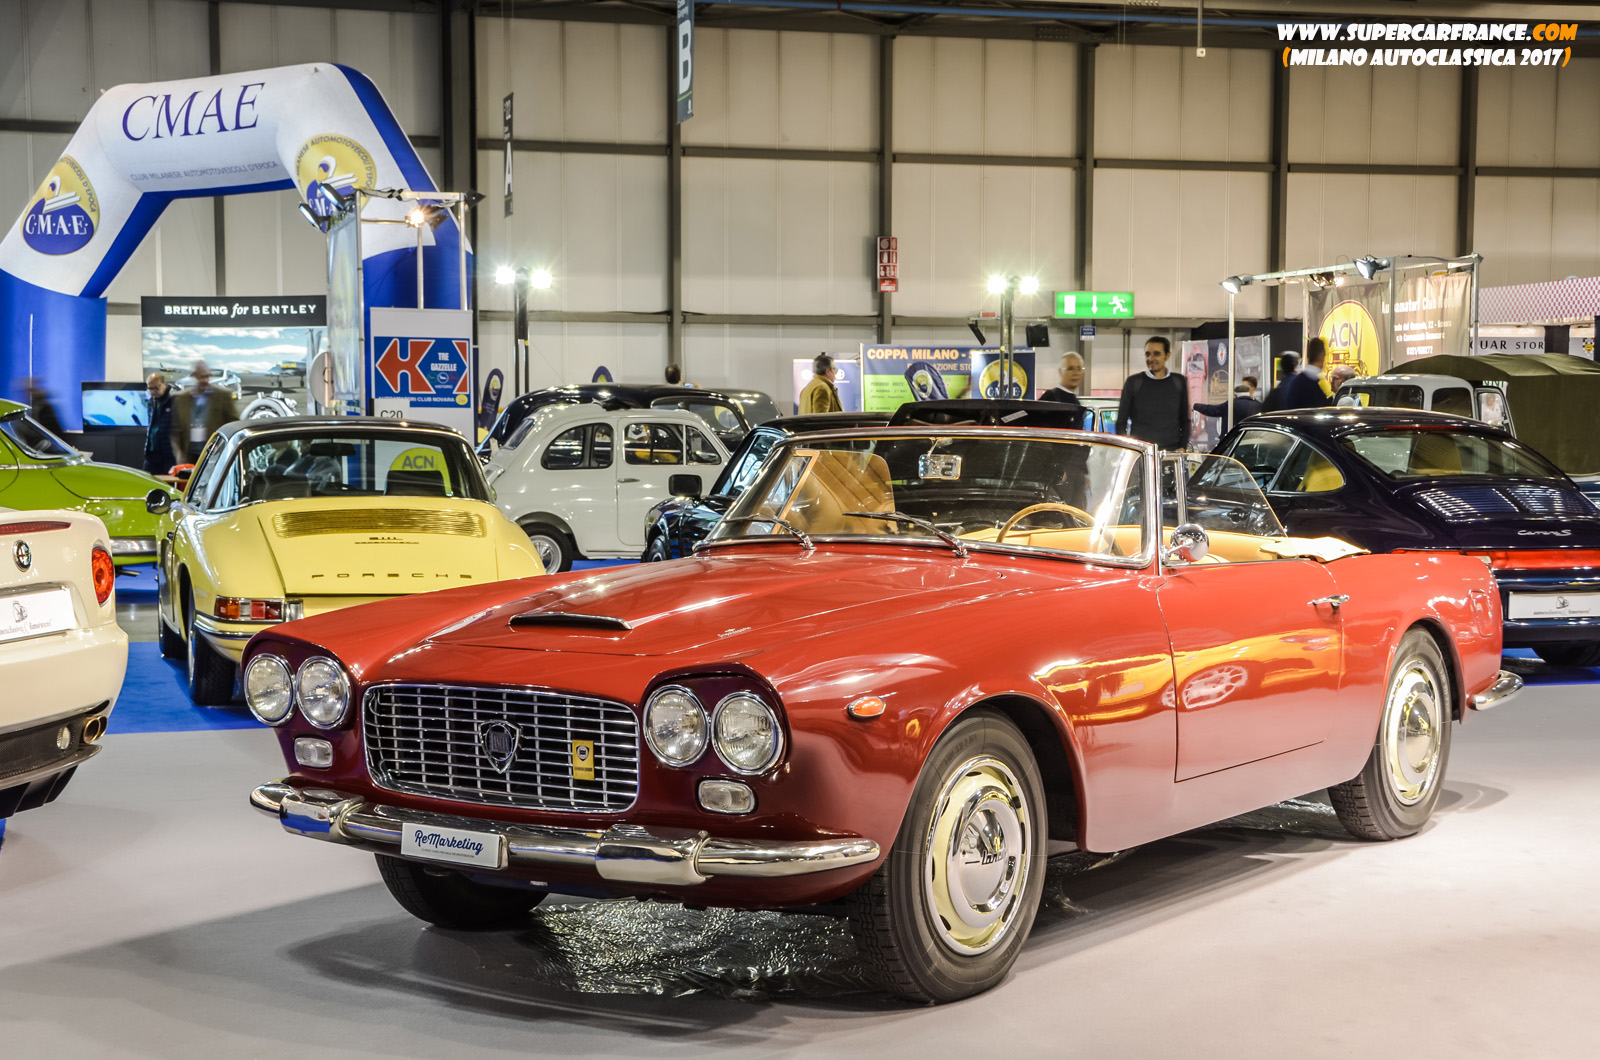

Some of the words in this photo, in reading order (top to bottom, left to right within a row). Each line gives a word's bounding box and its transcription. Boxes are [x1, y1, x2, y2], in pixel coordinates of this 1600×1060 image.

[678, 20, 692, 94] B
[122, 82, 265, 142] CMAE
[130, 173, 150, 181] CLUB
[150, 172, 182, 180] MILANESE
[184, 165, 247, 177] AUTOMOTOVEICOLI
[248, 161, 278, 172] D'EPOCA
[504, 141, 513, 196] A
[164, 306, 228, 315] BREITLING
[230, 304, 249, 318] for
[252, 304, 316, 314] BENTLEY
[1328, 321, 1358, 349] ACN
[438, 352, 449, 361] TRE
[867, 348, 908, 360] COPPA
[912, 349, 959, 360] MILANO
[430, 363, 457, 372] GAZZELLE
[402, 456, 434, 469] ACN
[415, 830, 484, 855] ReMarketing
